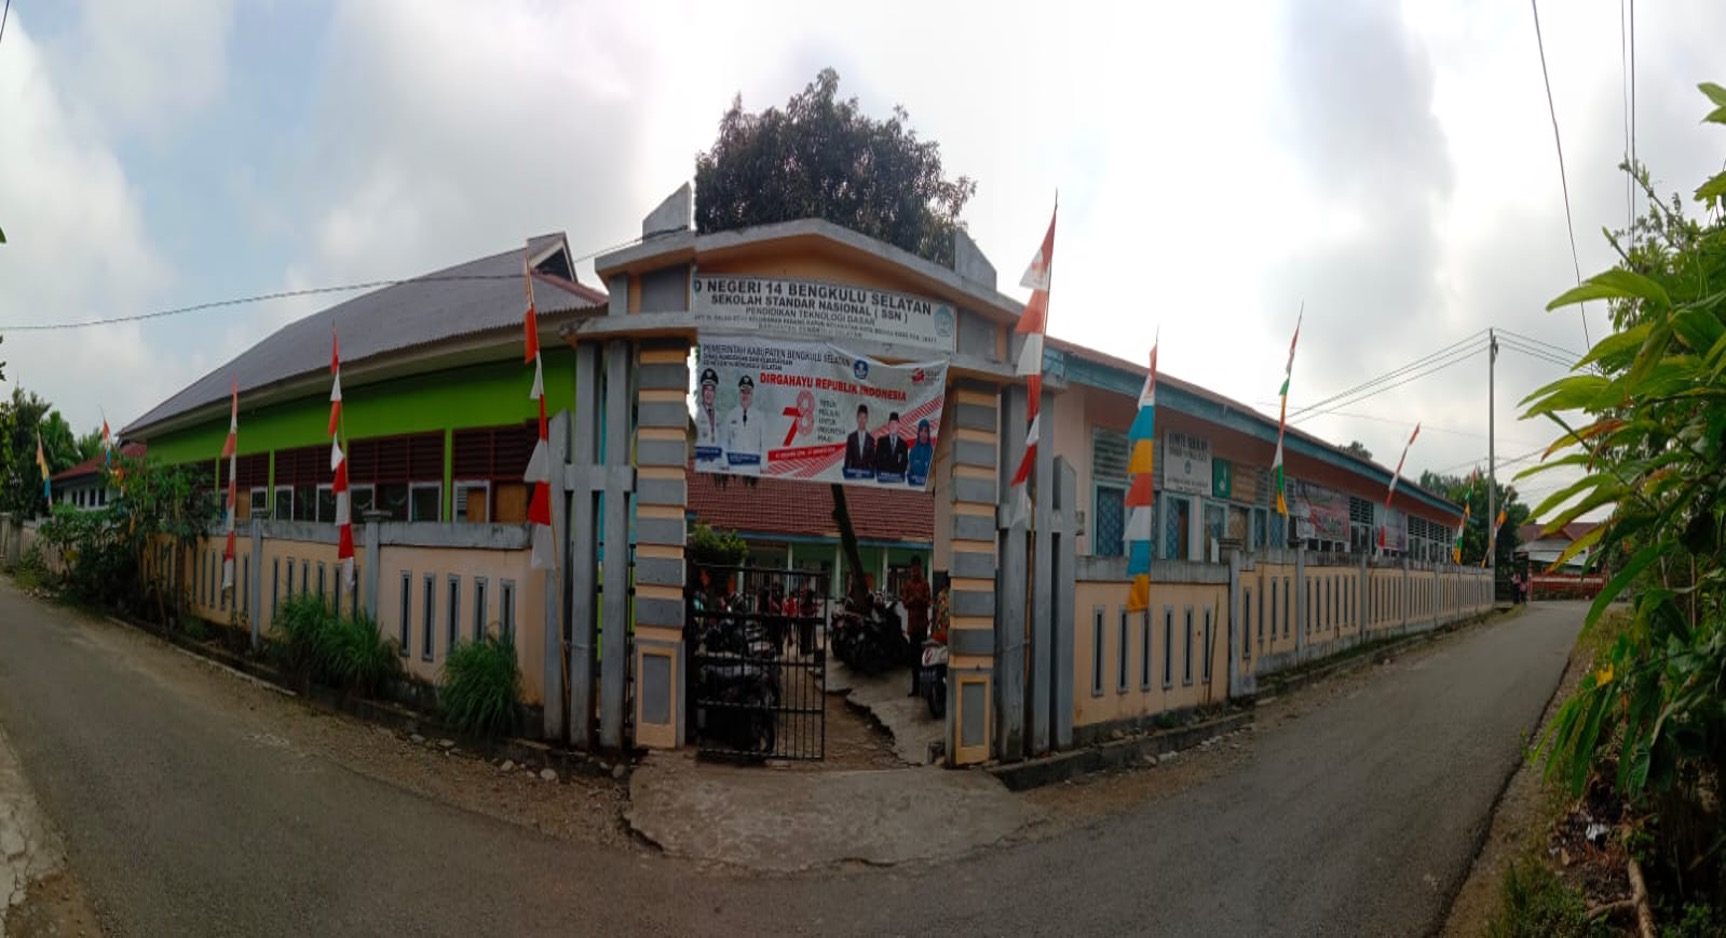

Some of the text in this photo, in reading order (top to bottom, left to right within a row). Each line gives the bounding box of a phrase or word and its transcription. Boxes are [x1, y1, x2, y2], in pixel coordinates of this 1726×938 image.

[707, 280, 761, 294] NEGERI
[766, 283, 782, 295] 14
[789, 284, 866, 304] BENGKULU
[871, 293, 931, 316] SELATAN
[712, 294, 762, 305] SEKOLAH
[765, 296, 815, 310] STANDAR
[818, 300, 871, 317] NASIONAL
[745, 307, 796, 318] PENDIDIKAN
[760, 372, 907, 402] DIRGAHAYU REPUBLIK INDONESIA
